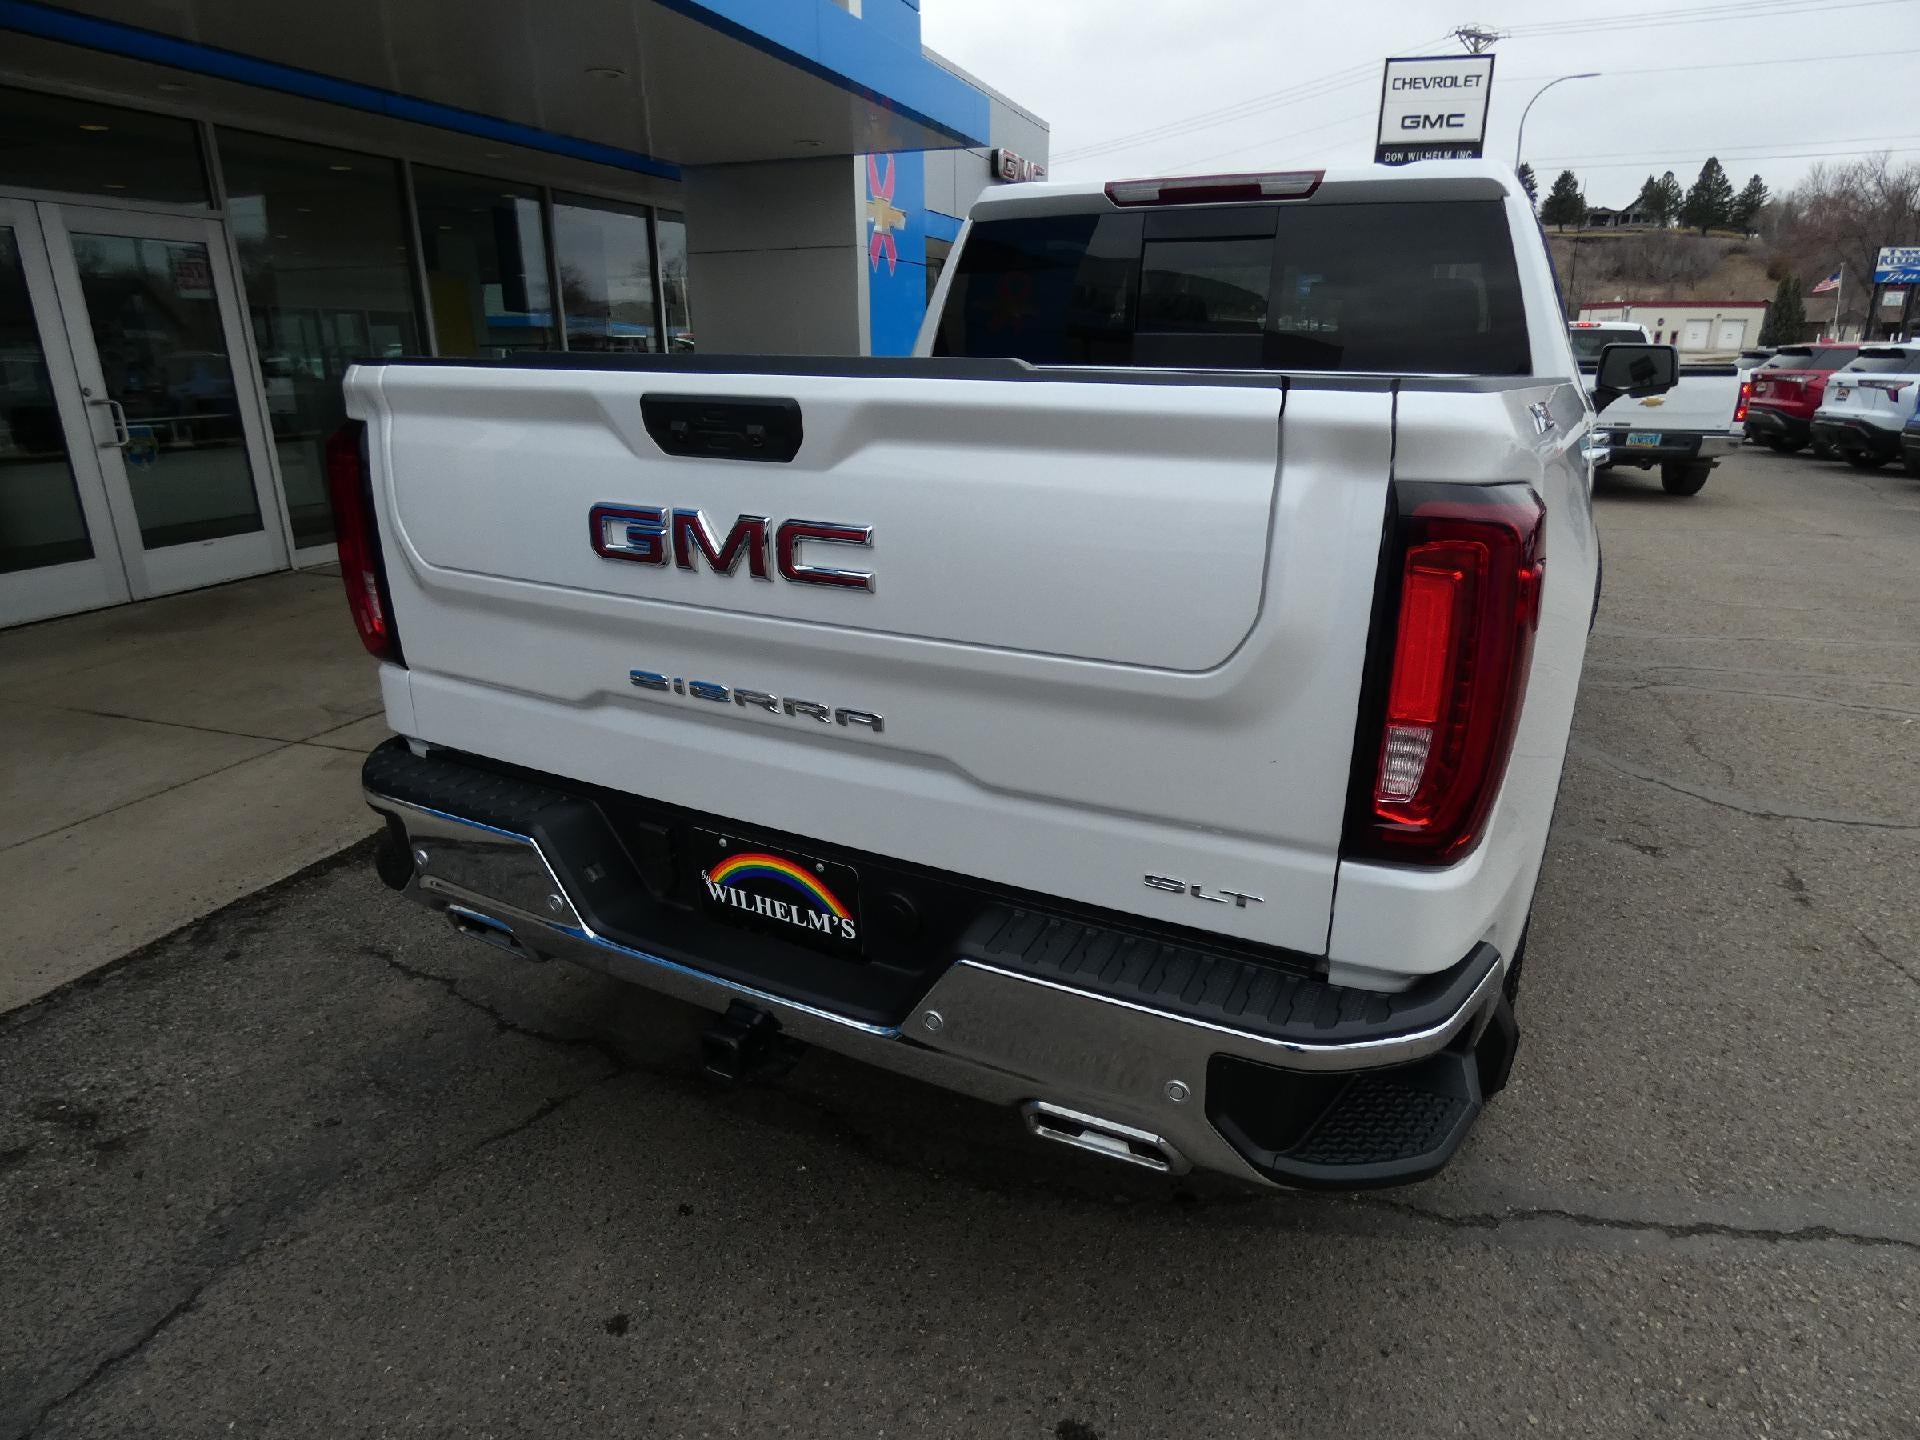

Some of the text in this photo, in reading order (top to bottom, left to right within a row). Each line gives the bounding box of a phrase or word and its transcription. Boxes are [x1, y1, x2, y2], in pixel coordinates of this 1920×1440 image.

[1392, 74, 1483, 91] CHEVROLET
[1401, 113, 1466, 130] GMC
[1384, 150, 1473, 163] DON WILHELM INC
[589, 502, 876, 594] GMC
[629, 669, 885, 733] SIERRA
[1144, 873, 1265, 908] SLT
[708, 882, 856, 939] WILHELM'S
